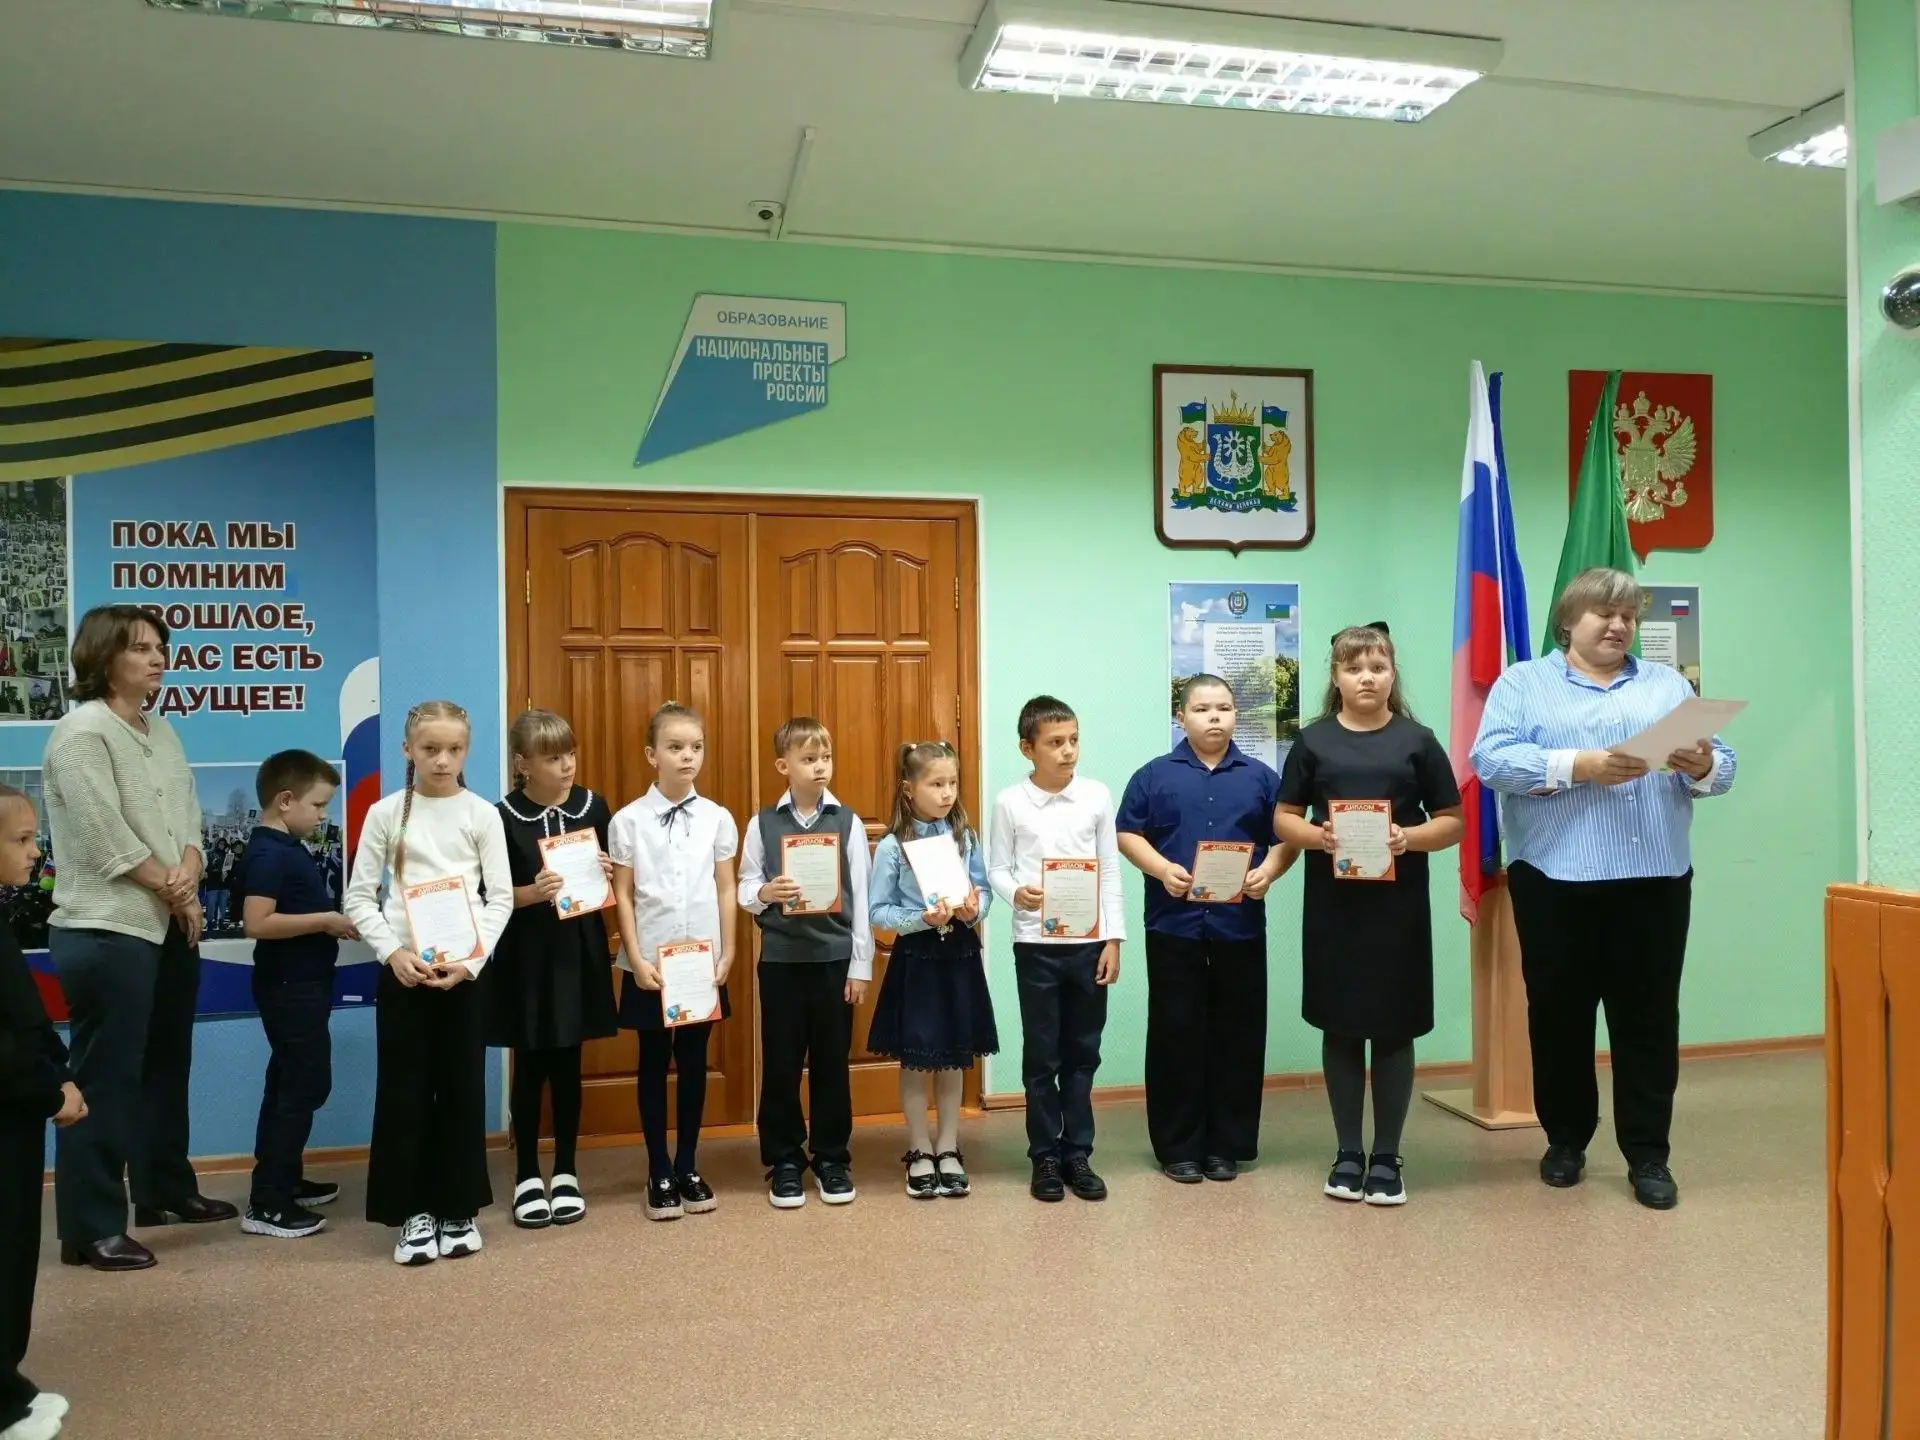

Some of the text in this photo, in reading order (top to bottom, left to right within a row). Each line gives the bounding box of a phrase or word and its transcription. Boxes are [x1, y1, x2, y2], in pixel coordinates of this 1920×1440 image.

[716, 310, 829, 329] ОБРАЗОВАНИЕ
[696, 338, 826, 363] НАЦИОНАЛЬНЫЕ
[752, 361, 826, 384] ПРОЕКТЫ
[766, 383, 826, 404] РОССИИ
[111, 520, 296, 550] ПОКА МЫ
[111, 561, 286, 591] ПОМНИМ
[112, 602, 315, 637] ОШЛОЕ,
[231, 643, 325, 673] ЕСТЬ
[140, 684, 306, 718] УДУЩЕЕ!
